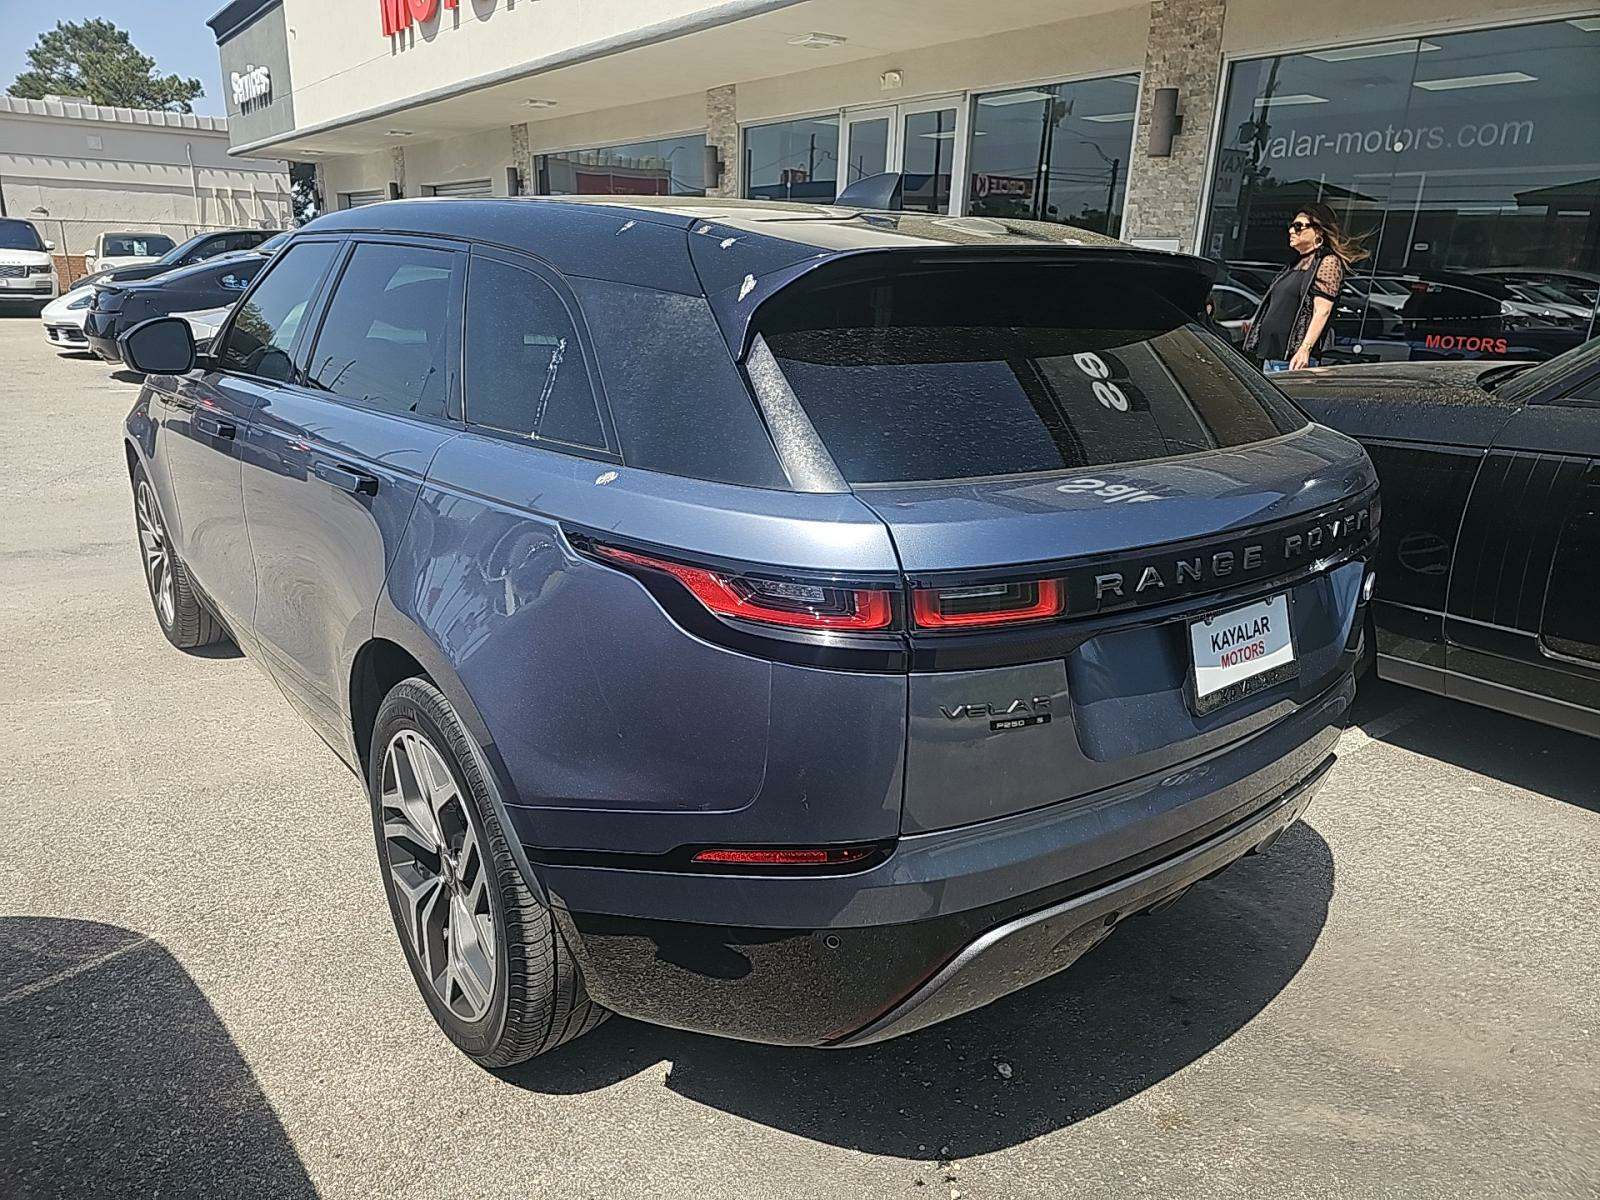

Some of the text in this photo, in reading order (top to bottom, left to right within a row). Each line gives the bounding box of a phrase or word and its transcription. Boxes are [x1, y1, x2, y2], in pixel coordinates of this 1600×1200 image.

[1425, 334, 1508, 354] MOTORS
[1094, 544, 1263, 599] RANGE
[1210, 616, 1271, 653] KAYALAR
[1221, 640, 1265, 669] MOTORS
[939, 695, 1052, 719] VELAR
[996, 719, 1025, 729] P250
